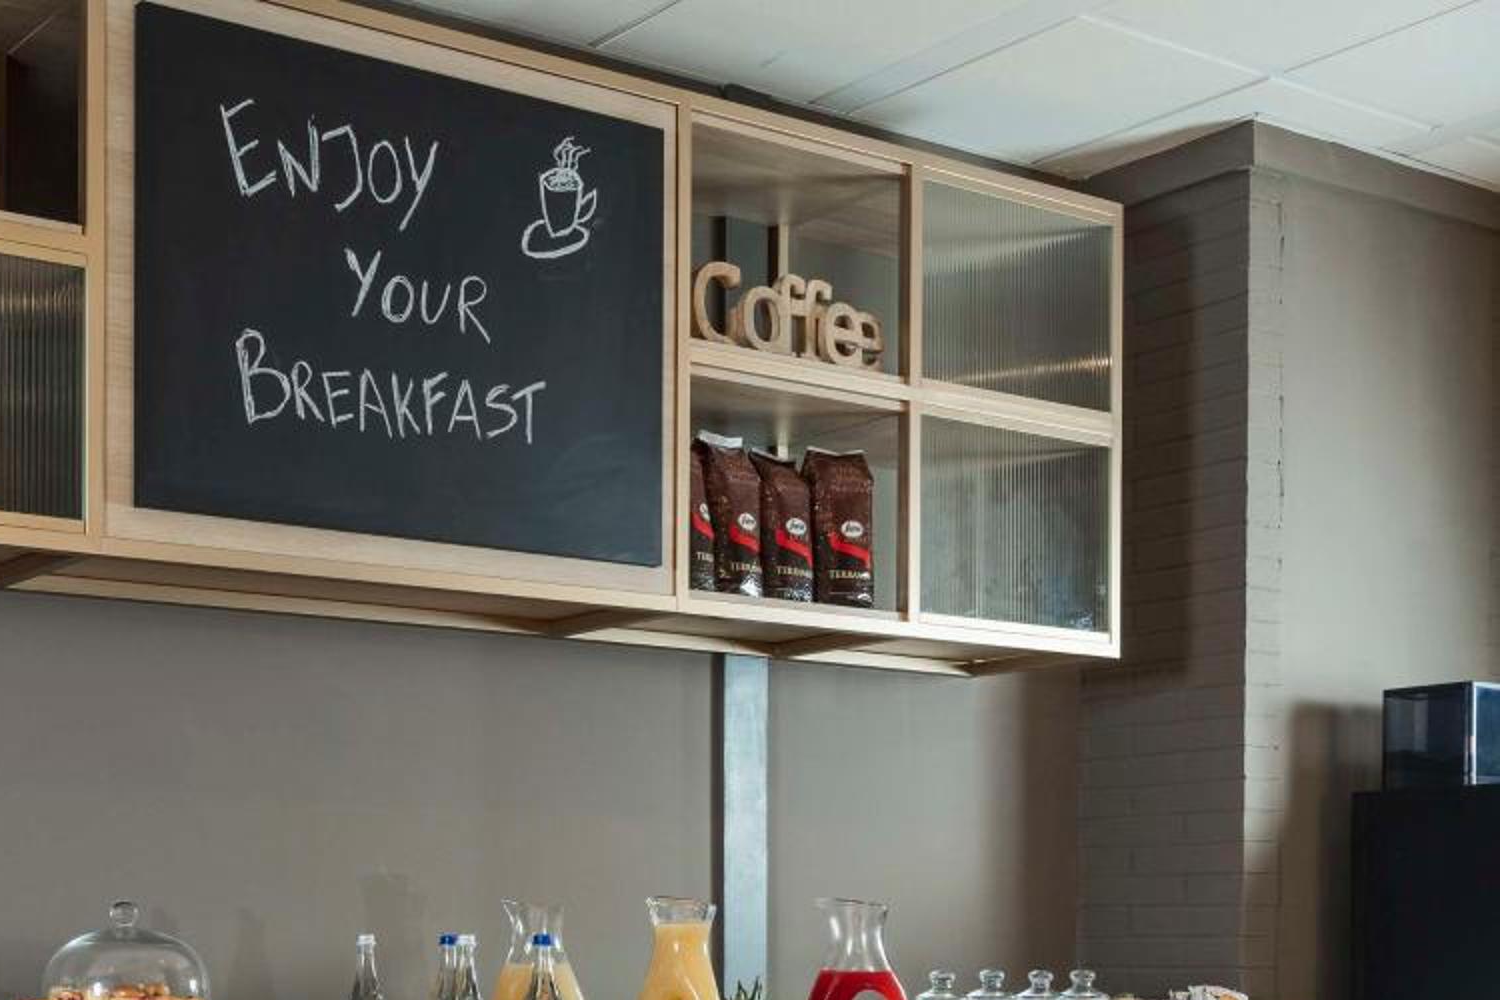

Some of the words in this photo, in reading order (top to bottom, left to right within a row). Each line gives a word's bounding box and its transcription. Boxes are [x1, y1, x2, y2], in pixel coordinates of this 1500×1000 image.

[345, 248, 490, 344] YOUR
[692, 261, 885, 370] Coffee
[235, 329, 546, 444] BREAKFAST
